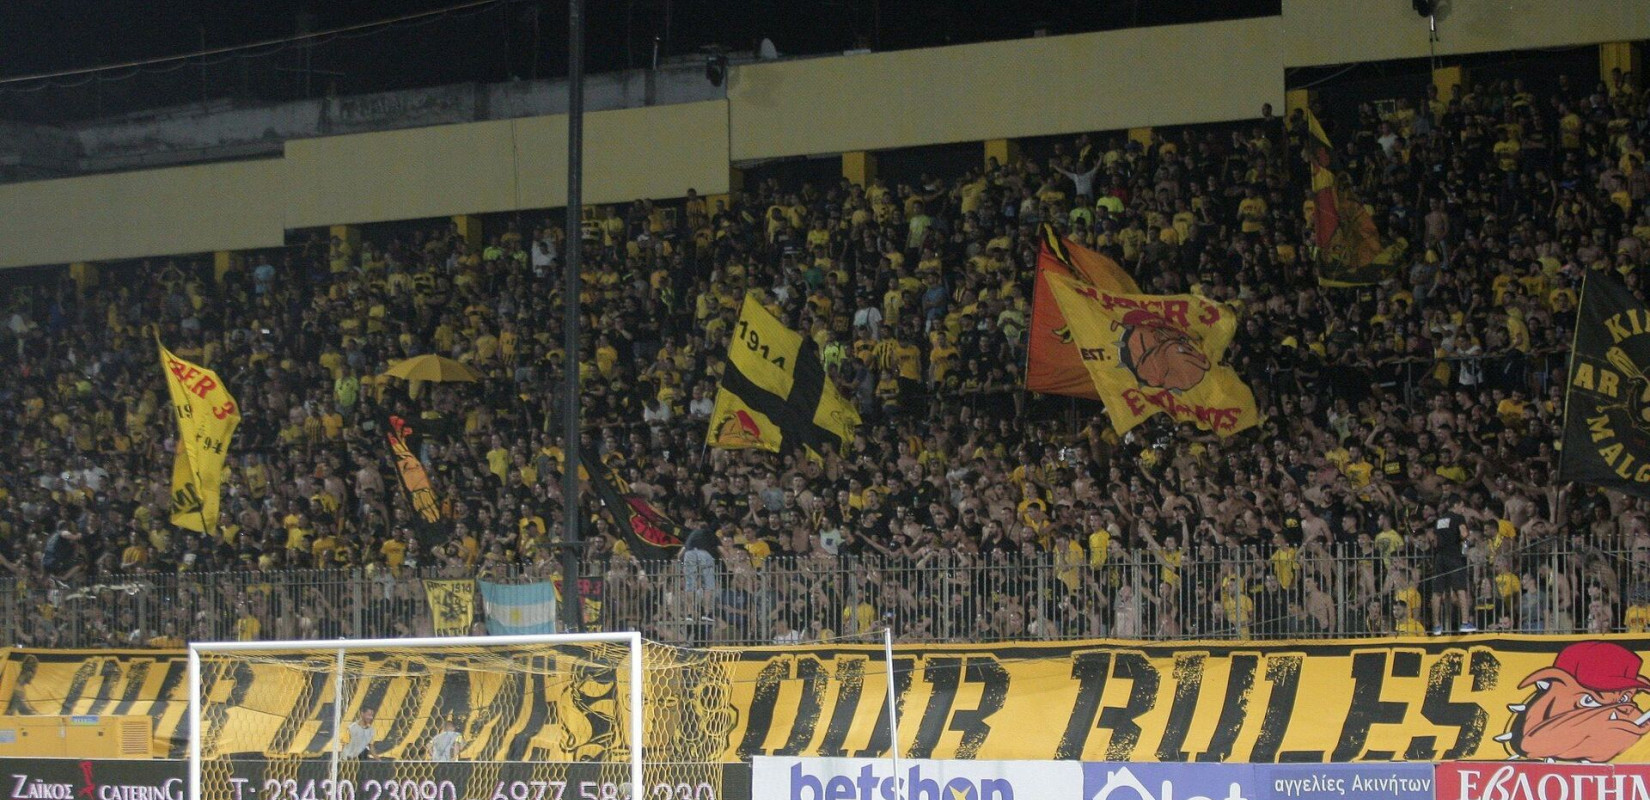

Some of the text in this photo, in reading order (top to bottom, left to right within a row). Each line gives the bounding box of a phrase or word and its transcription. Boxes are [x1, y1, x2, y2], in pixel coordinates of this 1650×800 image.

[1199, 299, 1221, 328] 3
[1080, 347, 1111, 362] EST.
[1573, 362, 1620, 398] AR
[177, 405, 193, 419] 19
[212, 401, 235, 420] 3
[736, 649, 1501, 763] OUR RULES
[364, 779, 458, 800] 23090
[490, 780, 567, 800] 6977
[1274, 774, 1346, 797] αγγελίες
[1351, 773, 1431, 797] Ακινήτων
